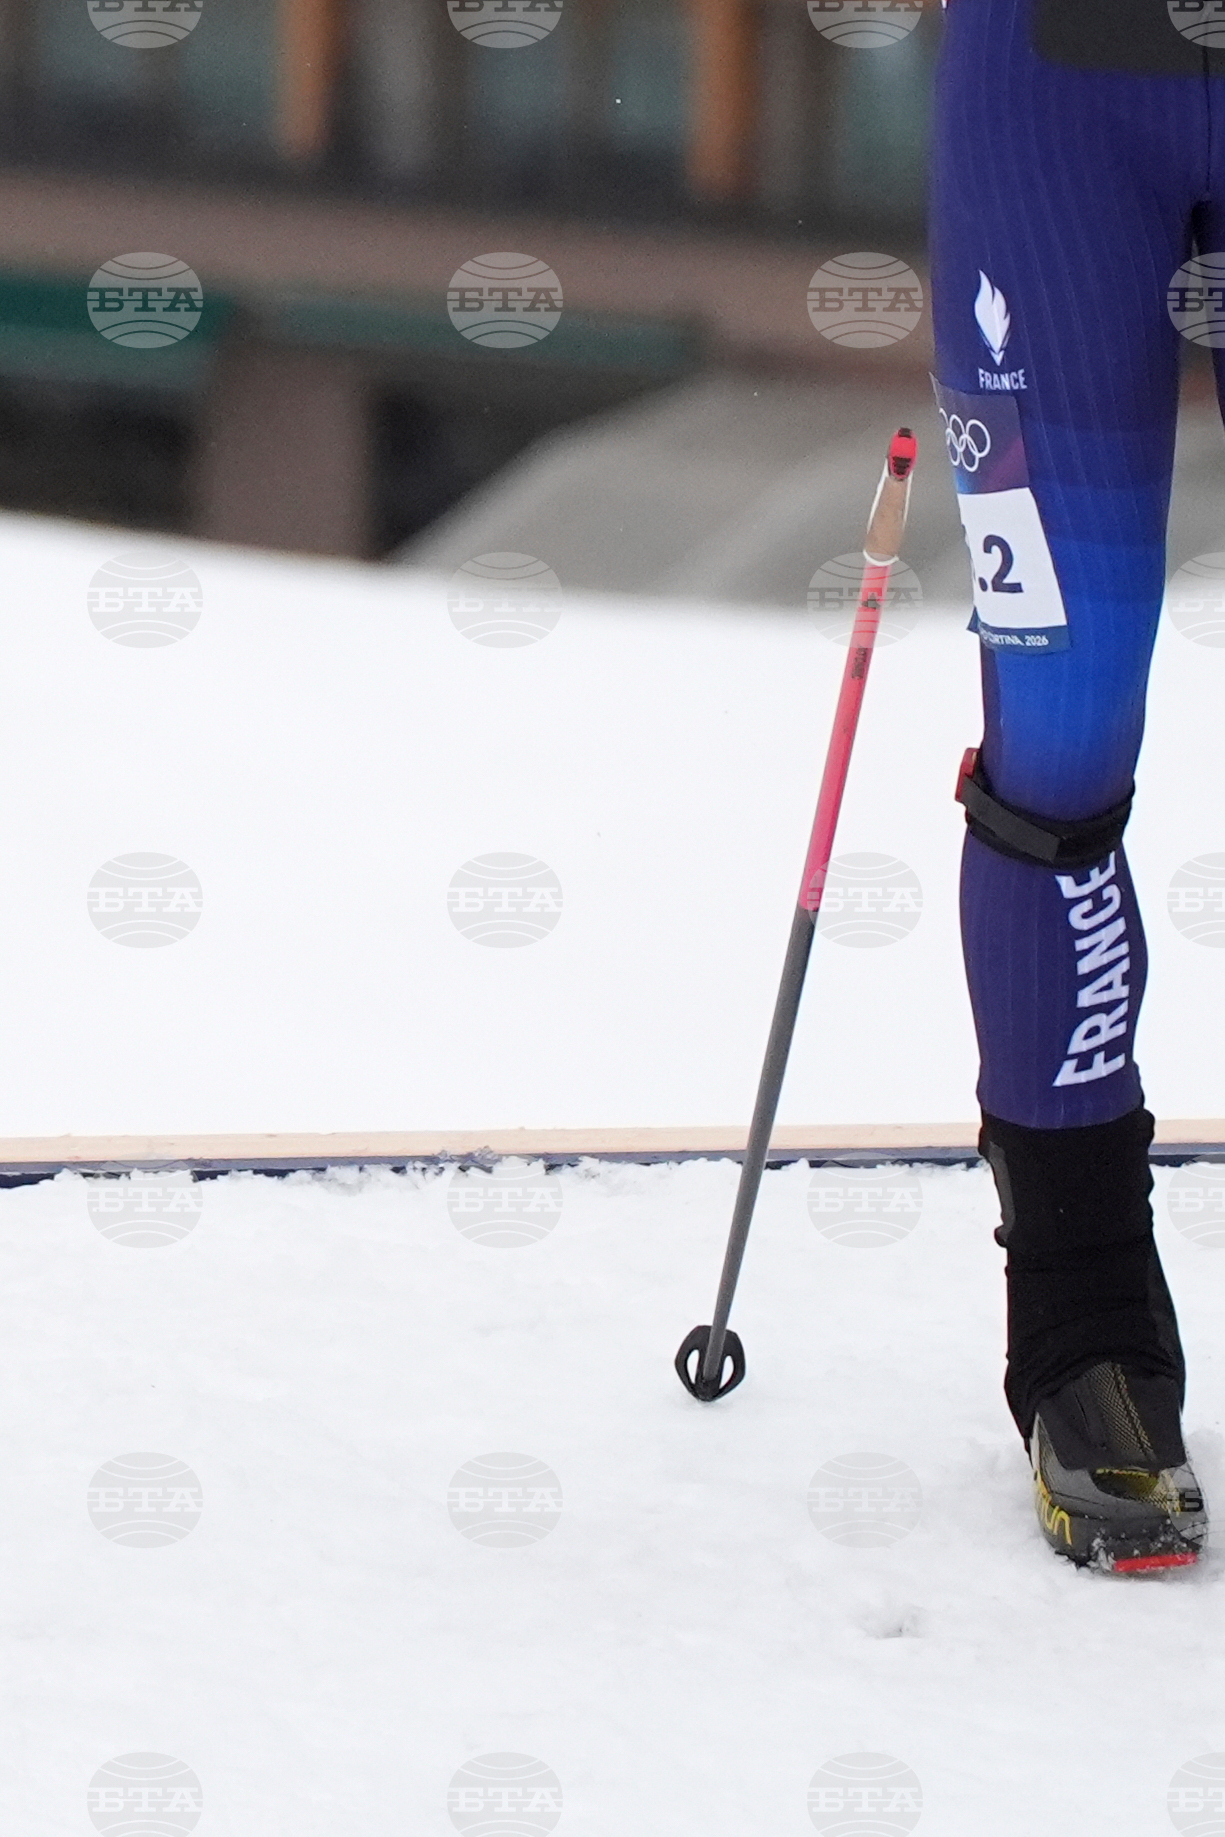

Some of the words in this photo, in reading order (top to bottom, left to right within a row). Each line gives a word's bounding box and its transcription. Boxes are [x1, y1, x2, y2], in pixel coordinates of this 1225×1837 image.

[977, 366, 1028, 391] FRANCE
[1024, 634, 1050, 647] 2026
[1052, 850, 1131, 1087] FRANCE
